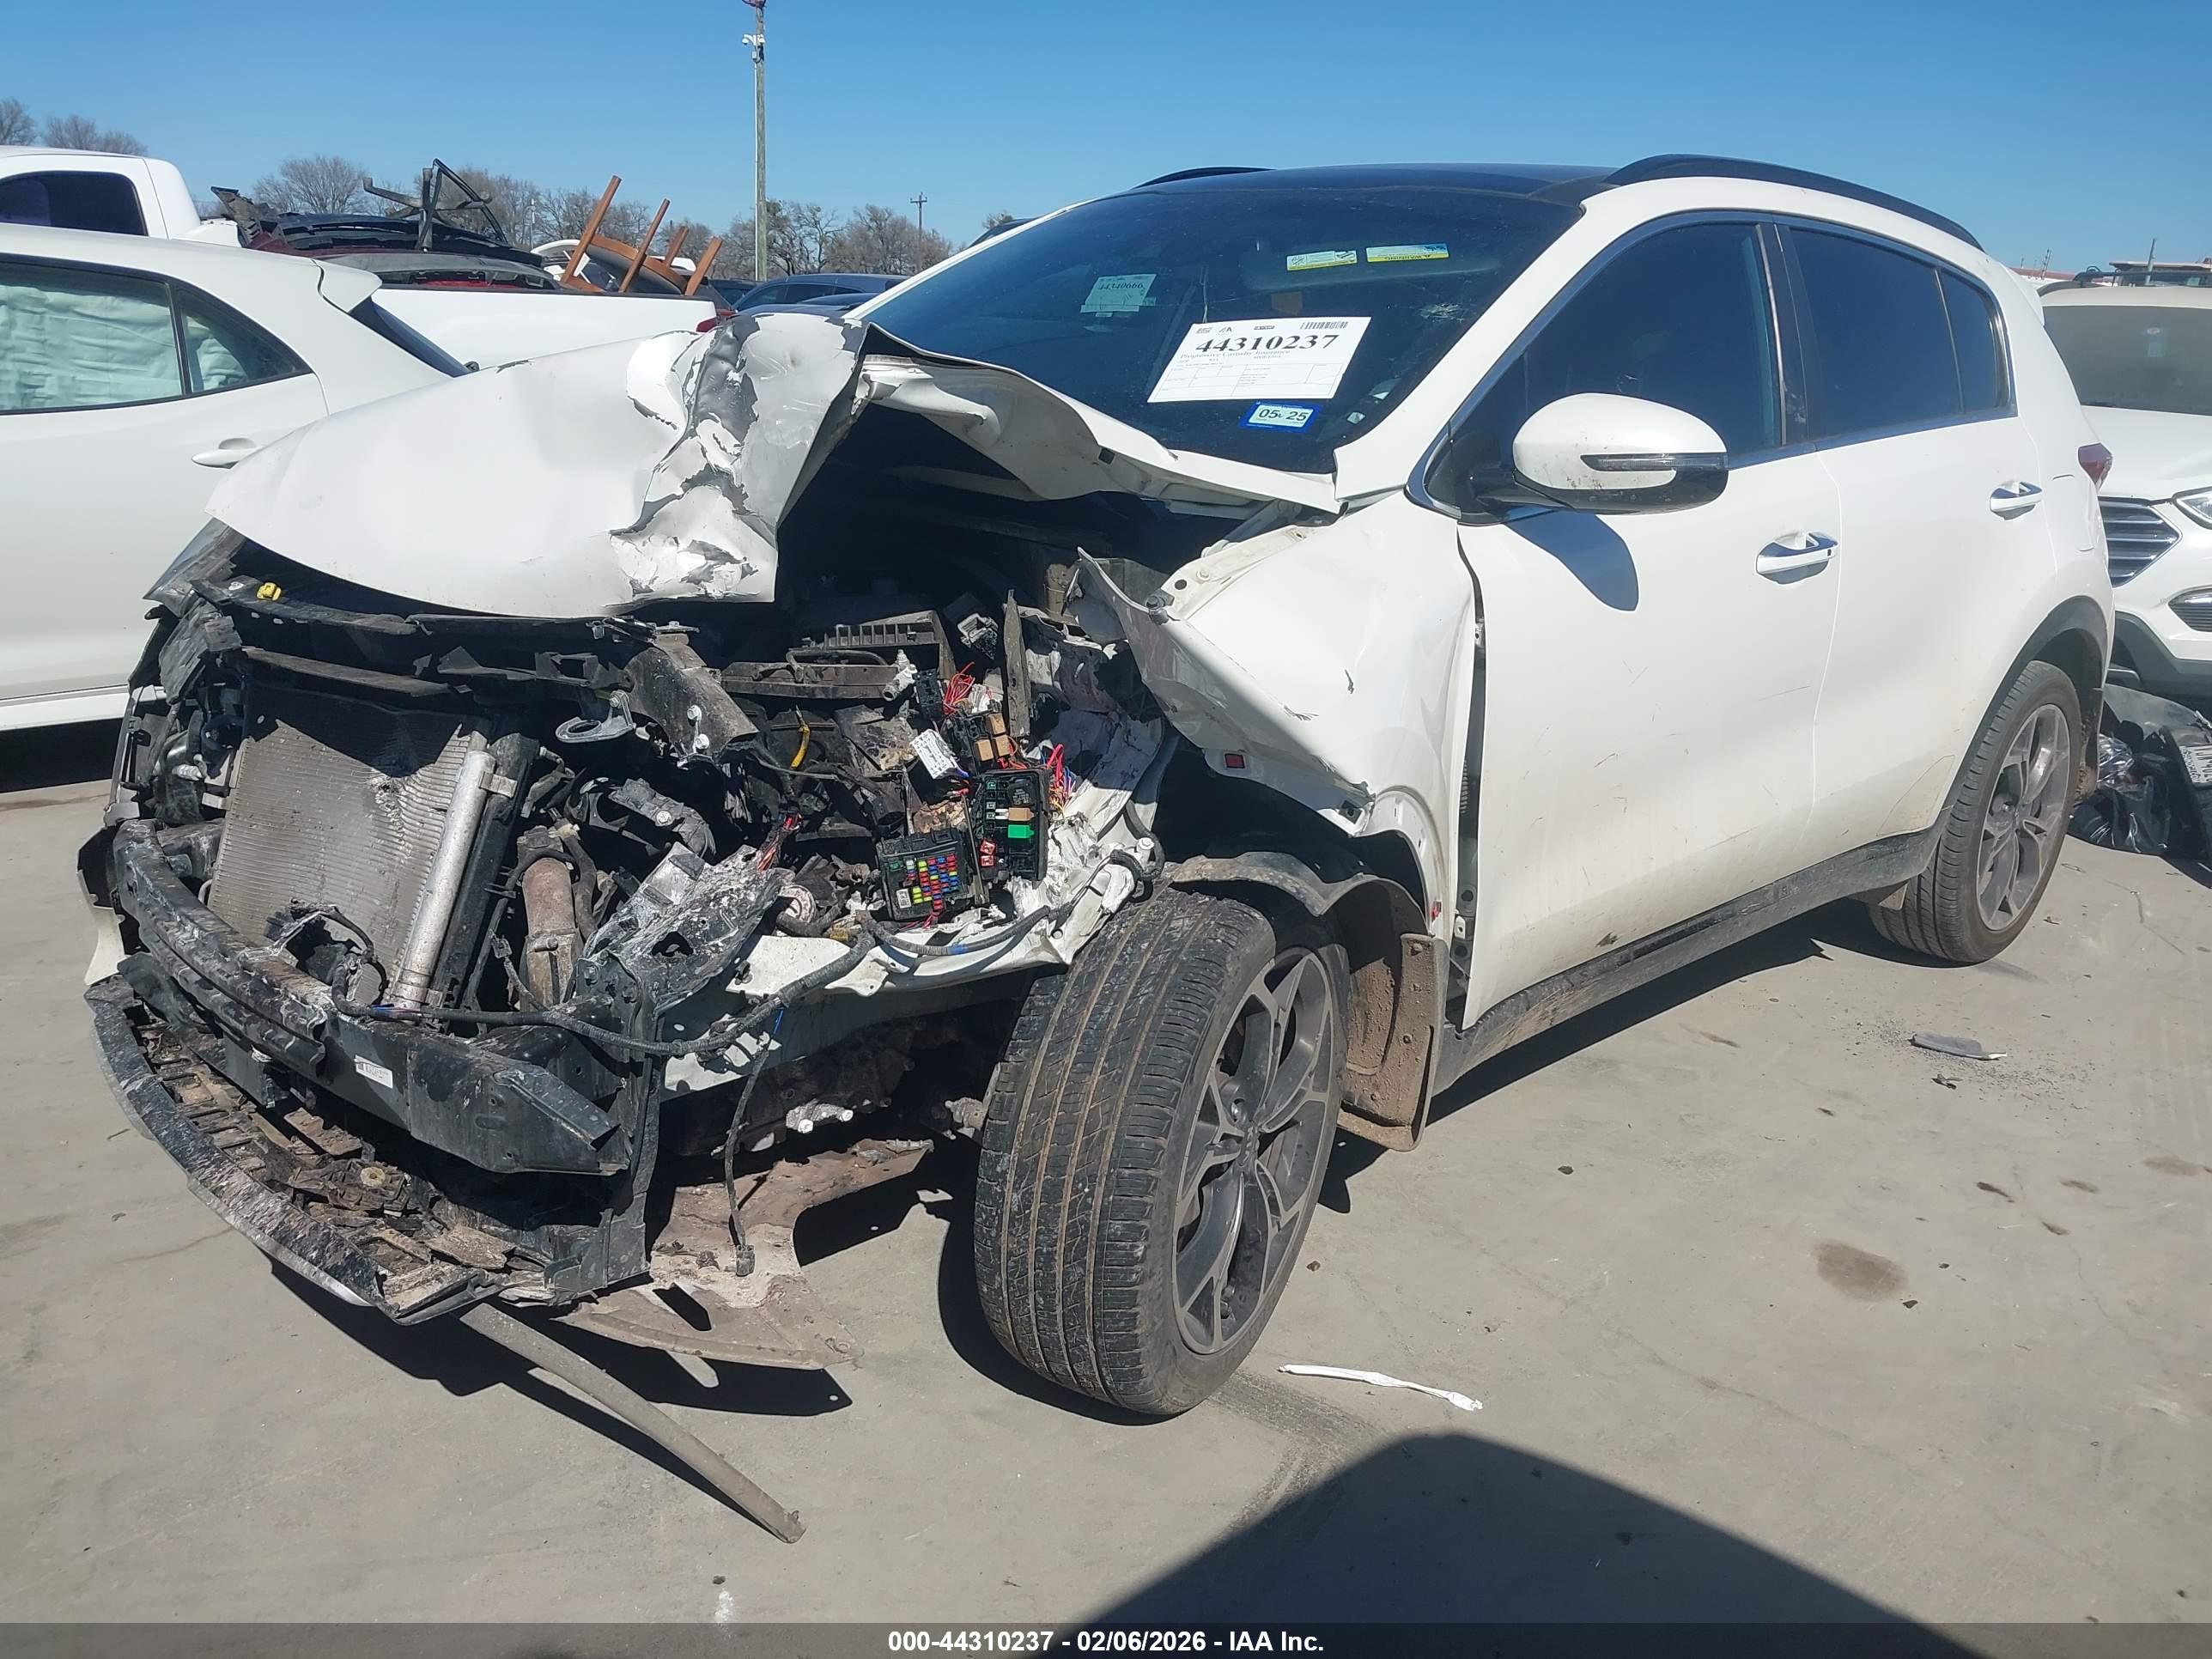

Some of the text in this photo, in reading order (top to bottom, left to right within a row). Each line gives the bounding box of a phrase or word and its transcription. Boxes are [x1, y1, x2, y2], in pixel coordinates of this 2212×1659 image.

[1195, 334, 1340, 353] 44310237
[1259, 409, 1310, 422] 05 25
